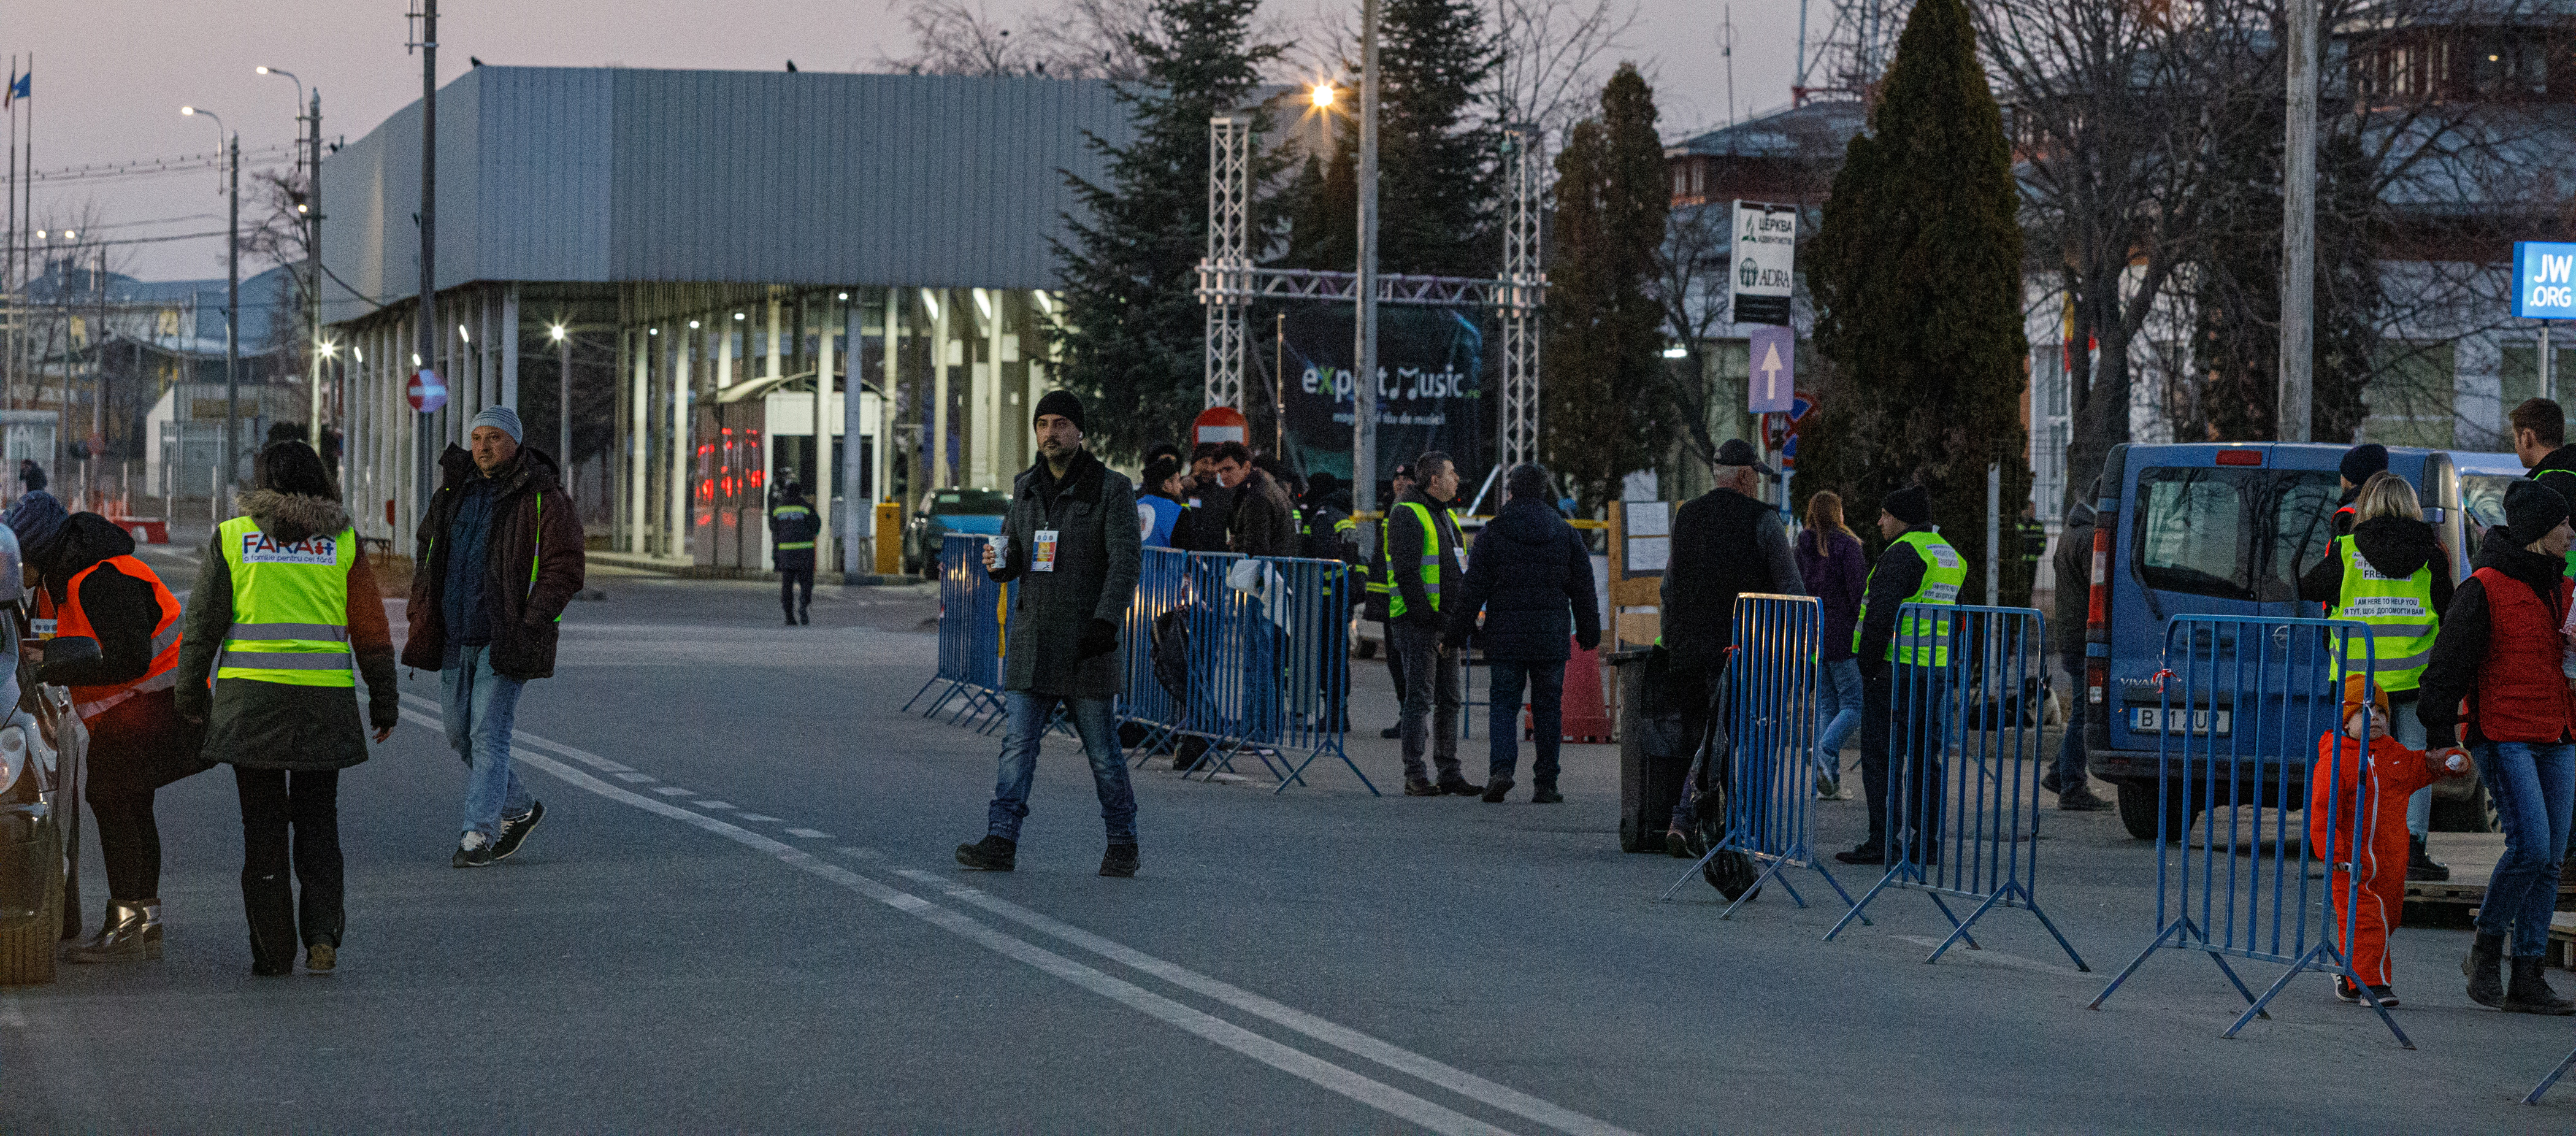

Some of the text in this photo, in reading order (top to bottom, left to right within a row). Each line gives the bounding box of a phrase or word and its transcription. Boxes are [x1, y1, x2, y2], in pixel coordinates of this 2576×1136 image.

[1759, 217, 1792, 232] ЦЕРКВА
[1759, 268, 1790, 288] ADRA
[2534, 254, 2574, 283] JW
[2530, 286, 2572, 307] .ORG
[2142, 710, 2153, 727] B
